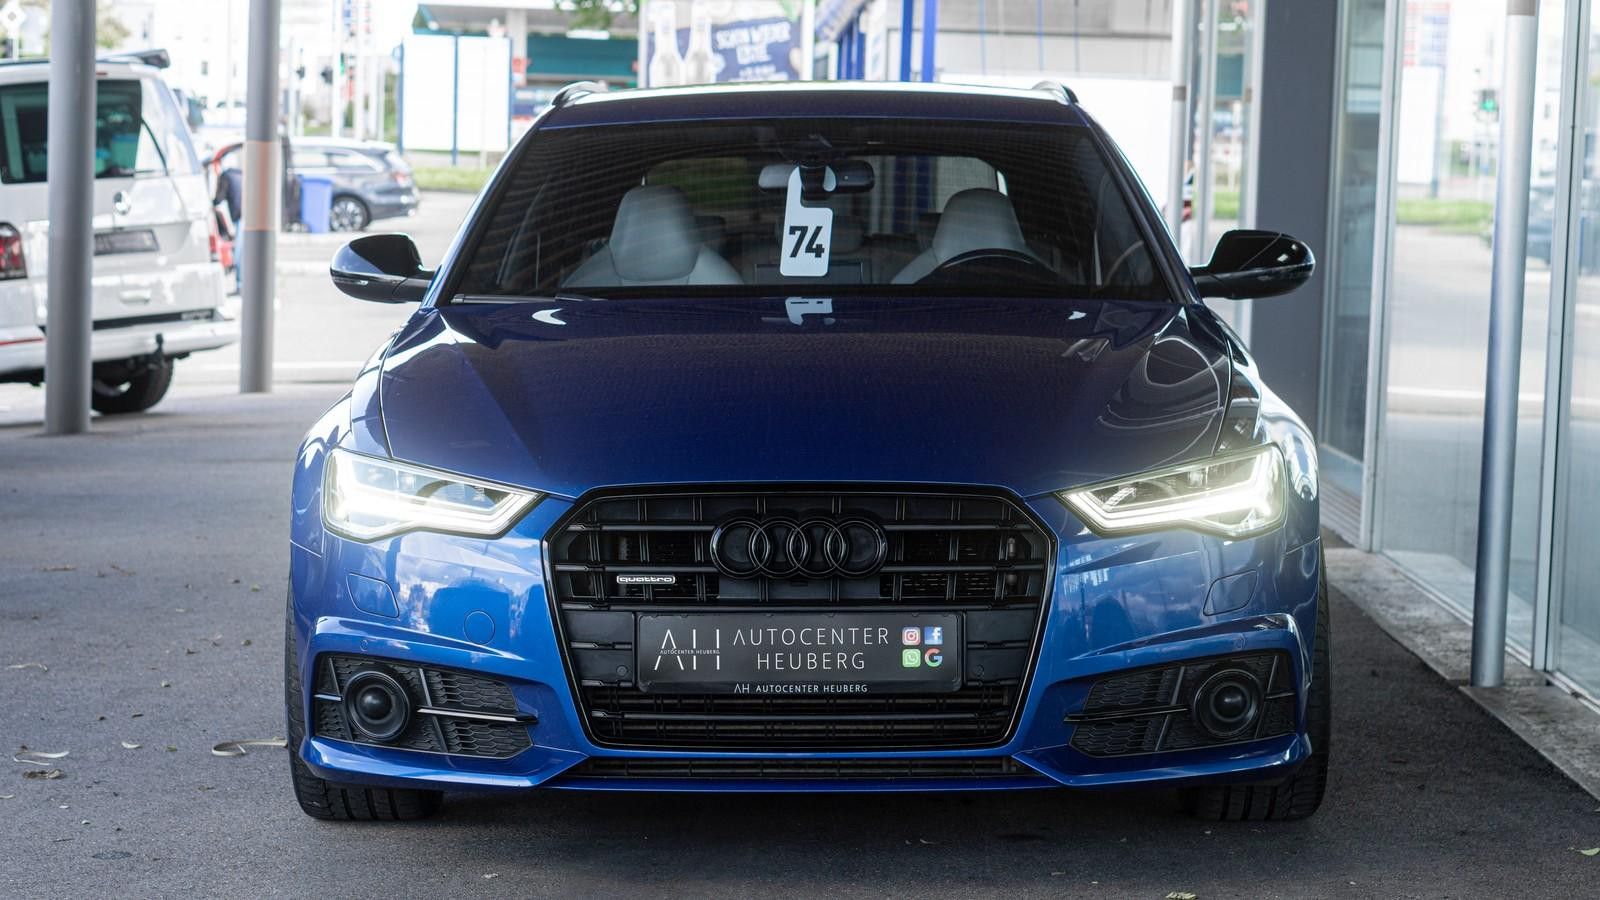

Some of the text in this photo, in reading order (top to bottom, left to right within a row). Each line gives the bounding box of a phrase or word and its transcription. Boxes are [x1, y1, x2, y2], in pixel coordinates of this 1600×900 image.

[788, 225, 826, 259] 74
[619, 575, 674, 584] quattro
[733, 627, 890, 647] AUTOCENTER
[654, 628, 721, 671] AH
[924, 648, 943, 668] G
[757, 652, 866, 671] HEUBERG
[734, 683, 868, 694] AH AUTOCENTER HEUBERG
